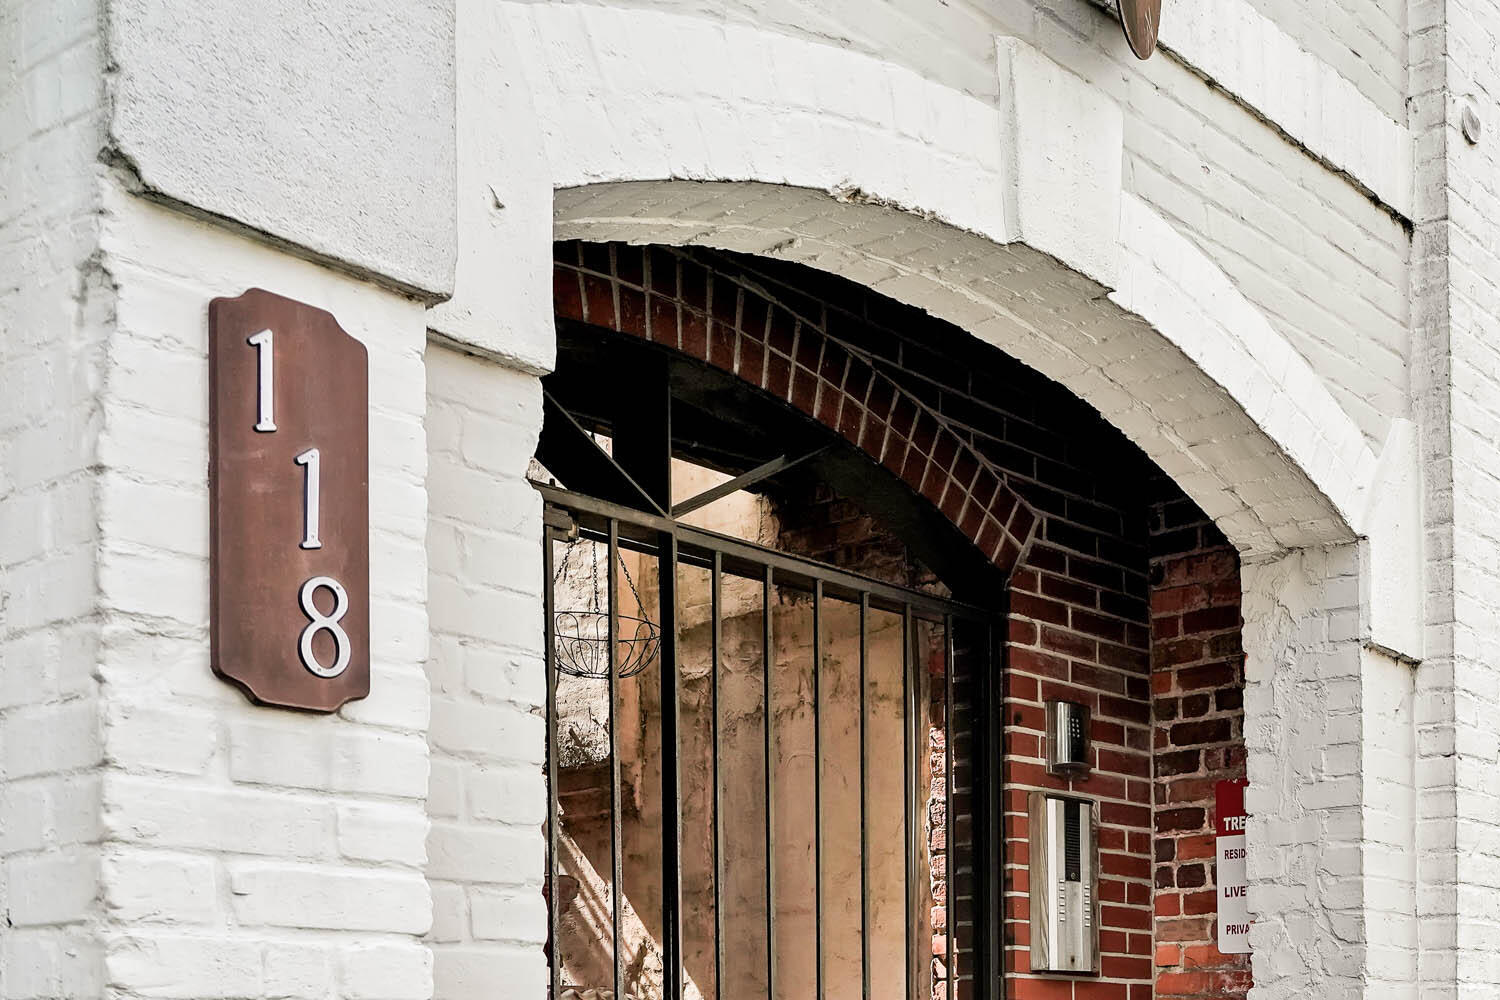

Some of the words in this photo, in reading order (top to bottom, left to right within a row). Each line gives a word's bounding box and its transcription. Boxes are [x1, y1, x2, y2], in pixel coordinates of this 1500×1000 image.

[1223, 816, 1246, 832] TRE
[1224, 849, 1247, 860] RESID
[1224, 885, 1248, 898] LIVE
[1226, 924, 1250, 935] PRIVA
